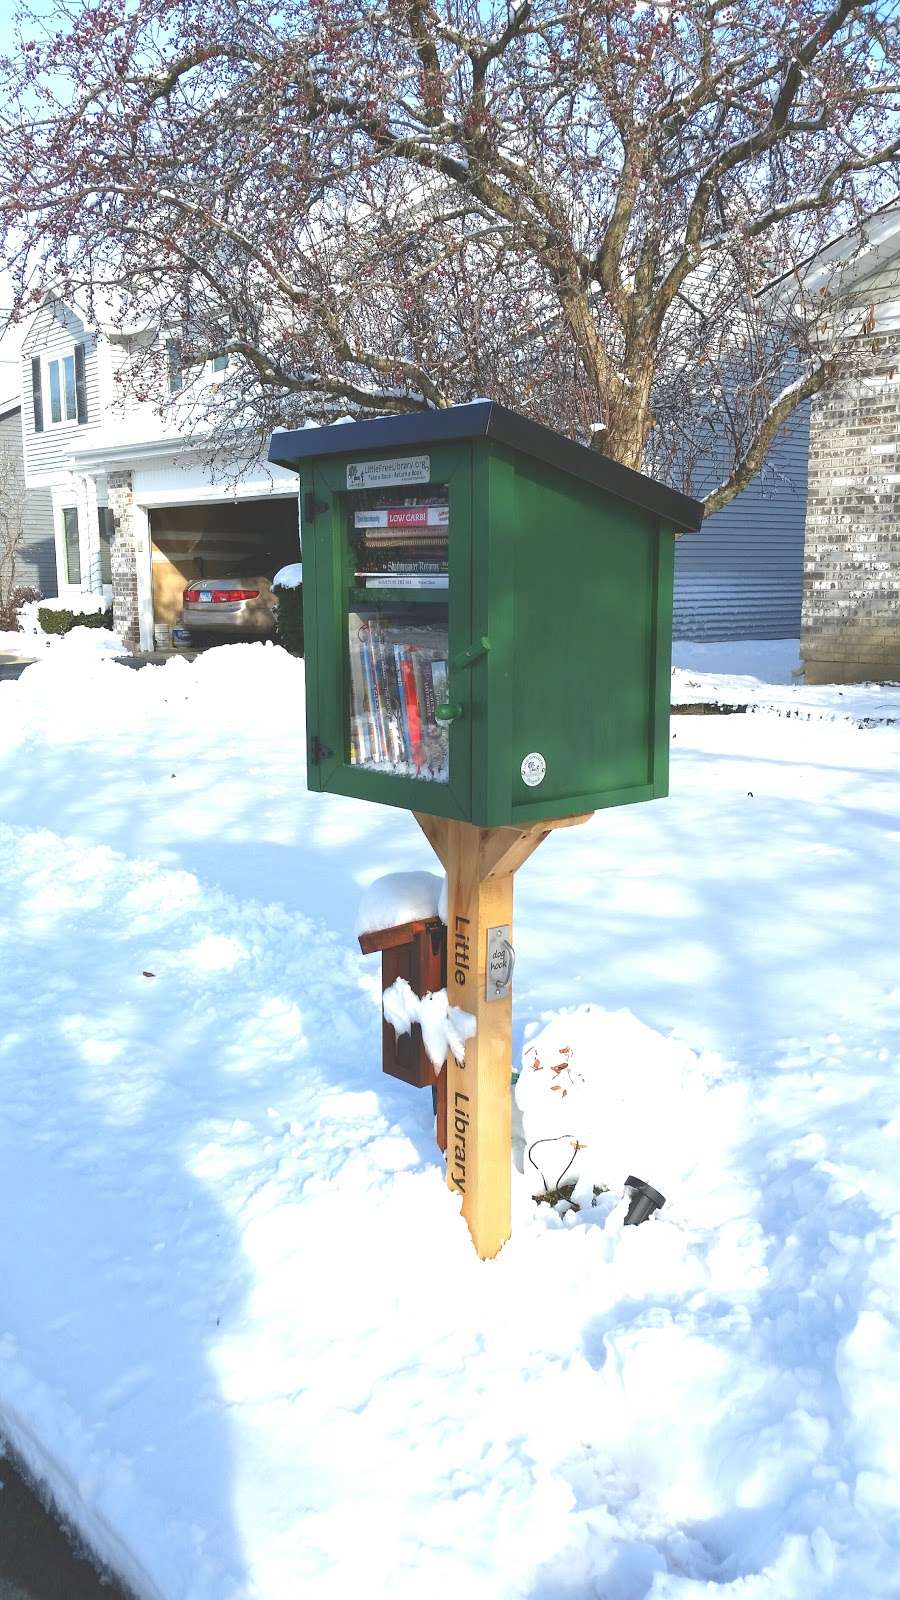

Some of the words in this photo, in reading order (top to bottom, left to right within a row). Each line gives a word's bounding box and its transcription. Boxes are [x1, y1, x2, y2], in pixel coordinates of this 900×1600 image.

[364, 460, 426, 474] LittleFreeLibrary.org
[389, 514, 405, 523] LOW
[455, 915, 470, 986] Little
[493, 949, 505, 959] dog
[490, 960, 507, 970] hook
[451, 1091, 469, 1193] Library
